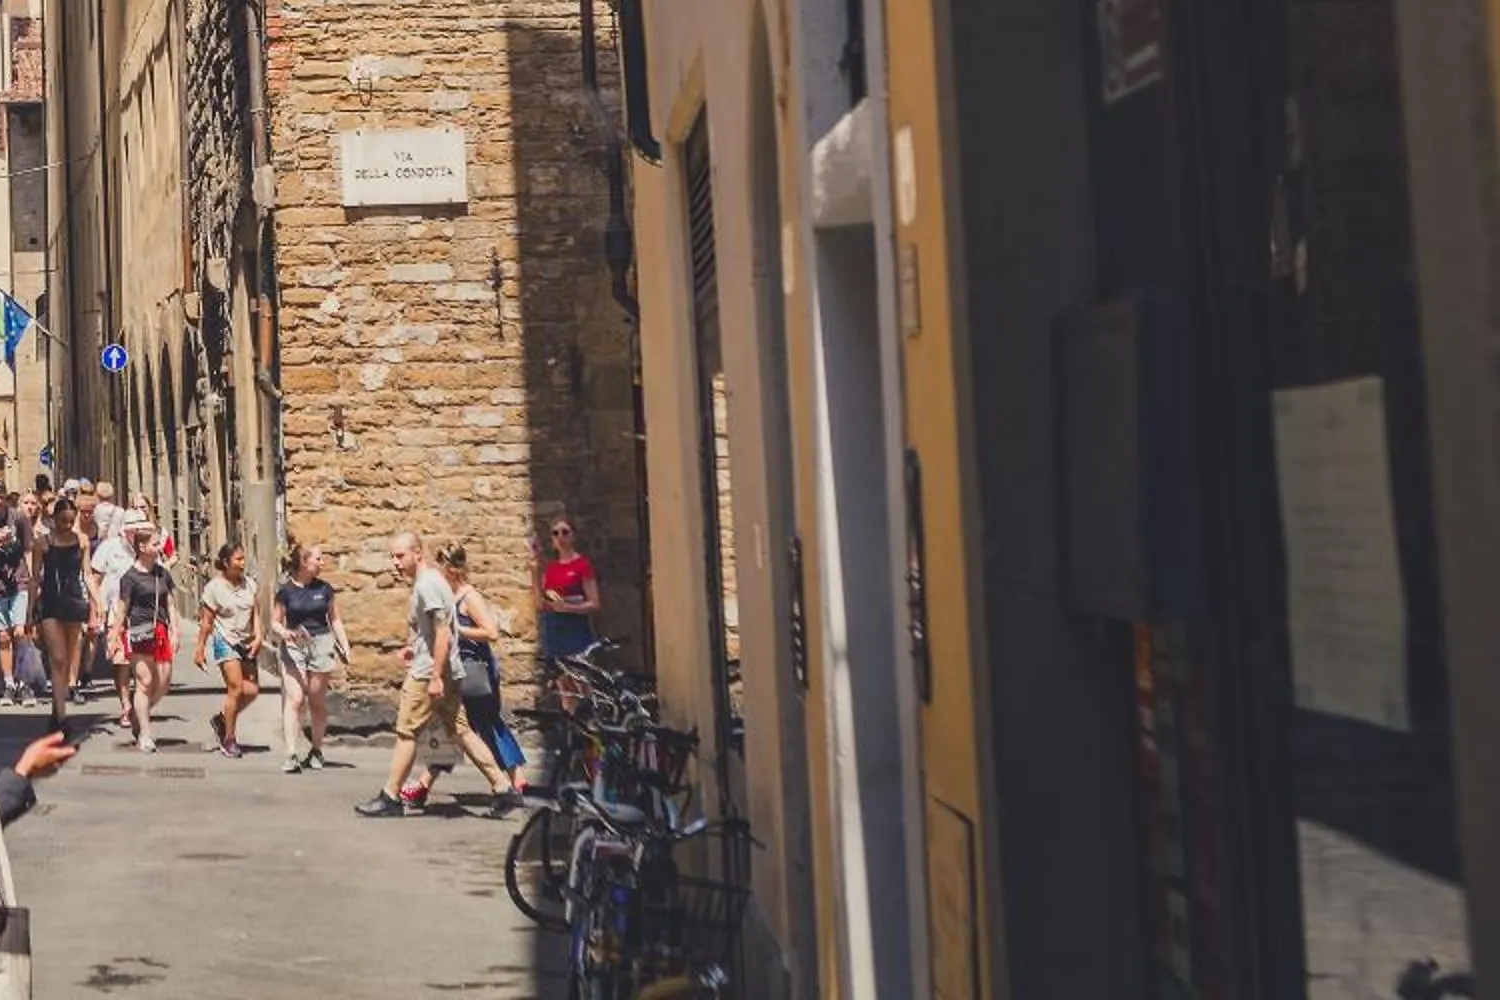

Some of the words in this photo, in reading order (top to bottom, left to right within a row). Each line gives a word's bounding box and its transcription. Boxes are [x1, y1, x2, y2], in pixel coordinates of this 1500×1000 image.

[393, 151, 413, 162] VIA
[355, 168, 389, 180] DELLA
[395, 166, 454, 180] CONDOTTA
